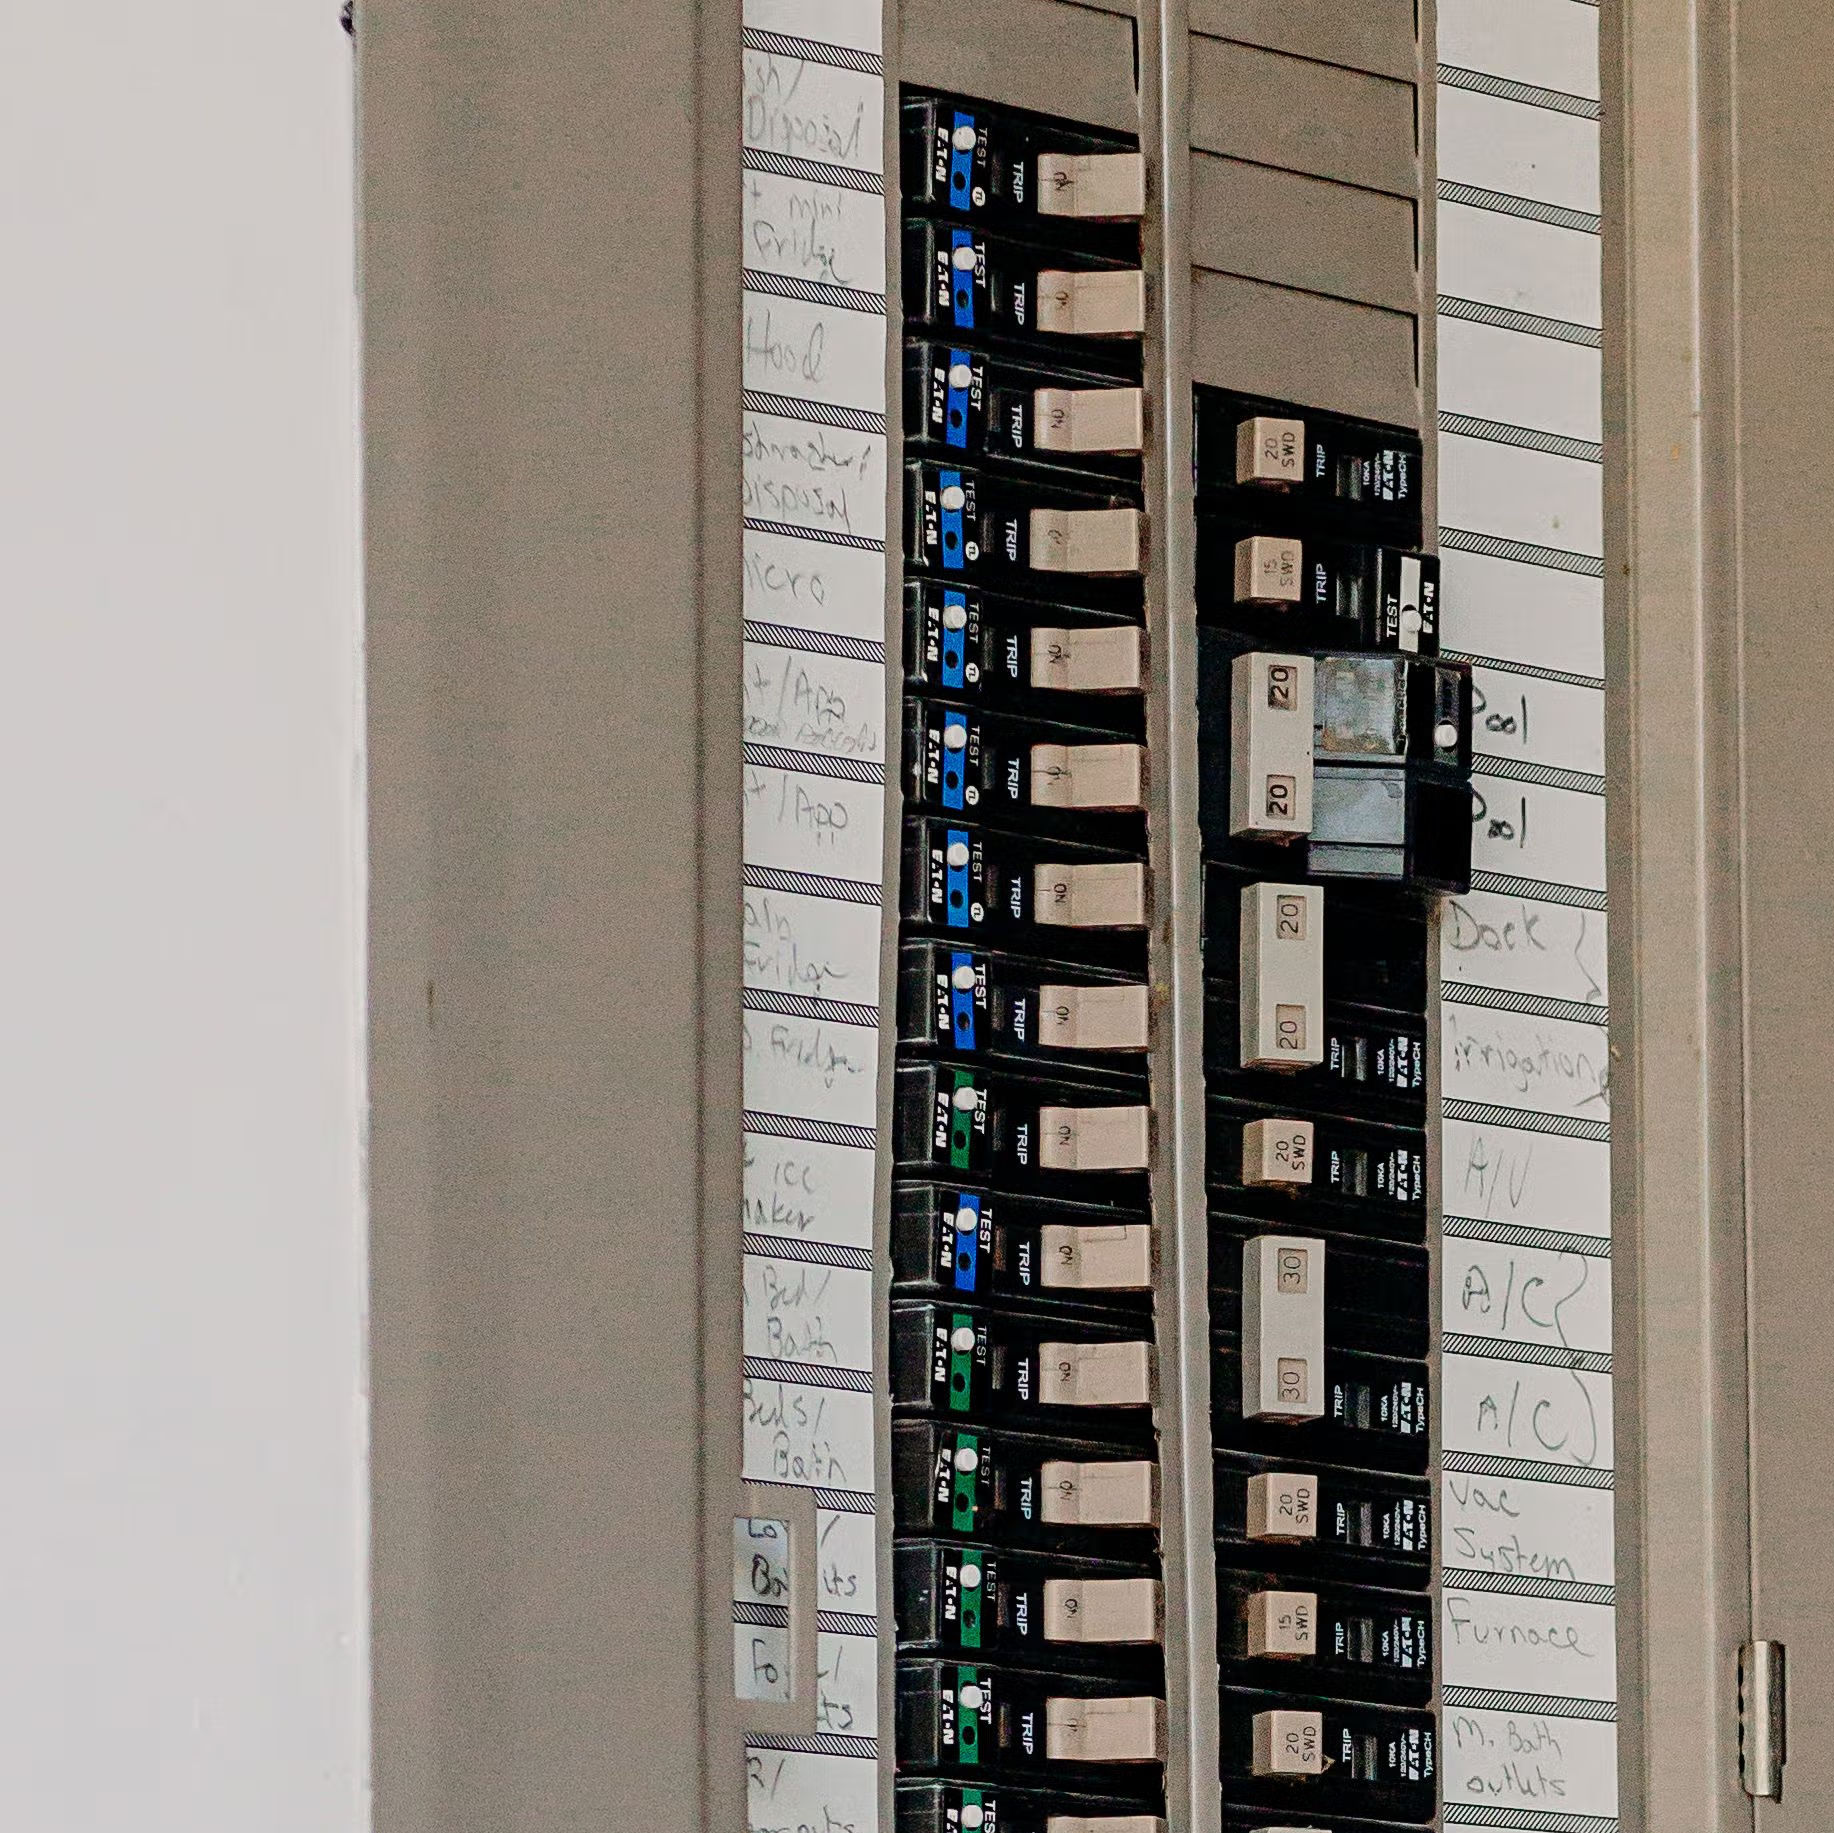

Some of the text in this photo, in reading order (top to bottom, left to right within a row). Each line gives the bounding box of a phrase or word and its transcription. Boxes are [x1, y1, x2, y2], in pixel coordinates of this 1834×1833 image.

[1011, 161, 1024, 203] TRIP
[973, 242, 986, 289] TEST
[1009, 405, 1023, 448] TRIP
[1316, 443, 1327, 477] TRIP
[965, 480, 976, 522] TEST
[968, 602, 980, 644] TEST
[1386, 594, 1399, 638] TEST
[1005, 635, 1018, 678] TRIP
[1270, 667, 1290, 699] 20
[1270, 783, 1288, 816] 20
[972, 841, 983, 882] TEST
[1009, 877, 1021, 919] TRIP
[1280, 903, 1299, 935] 20
[974, 963, 987, 1010] TEST
[1279, 1020, 1298, 1050] 20
[1016, 1123, 1029, 1166] TRIP
[1275, 1140, 1289, 1162] 20
[1292, 1134, 1307, 1170] SWD
[979, 1208, 993, 1255] TEST
[1283, 1256, 1301, 1286] 30
[1017, 1358, 1030, 1400] TRIP
[1282, 1371, 1300, 1401] 30
[1280, 1494, 1294, 1516] 20
[1296, 1487, 1311, 1524] SWD
[1336, 1502, 1347, 1536] TRIP
[986, 1561, 997, 1602] TEST
[1015, 1592, 1028, 1636] TRIP
[1295, 1604, 1309, 1641] SWD
[1446, 1596, 1596, 1658] Furnace
[978, 1678, 992, 1725] TEST
[1286, 1732, 1299, 1755] 20
[1303, 1725, 1317, 1762] SWD
